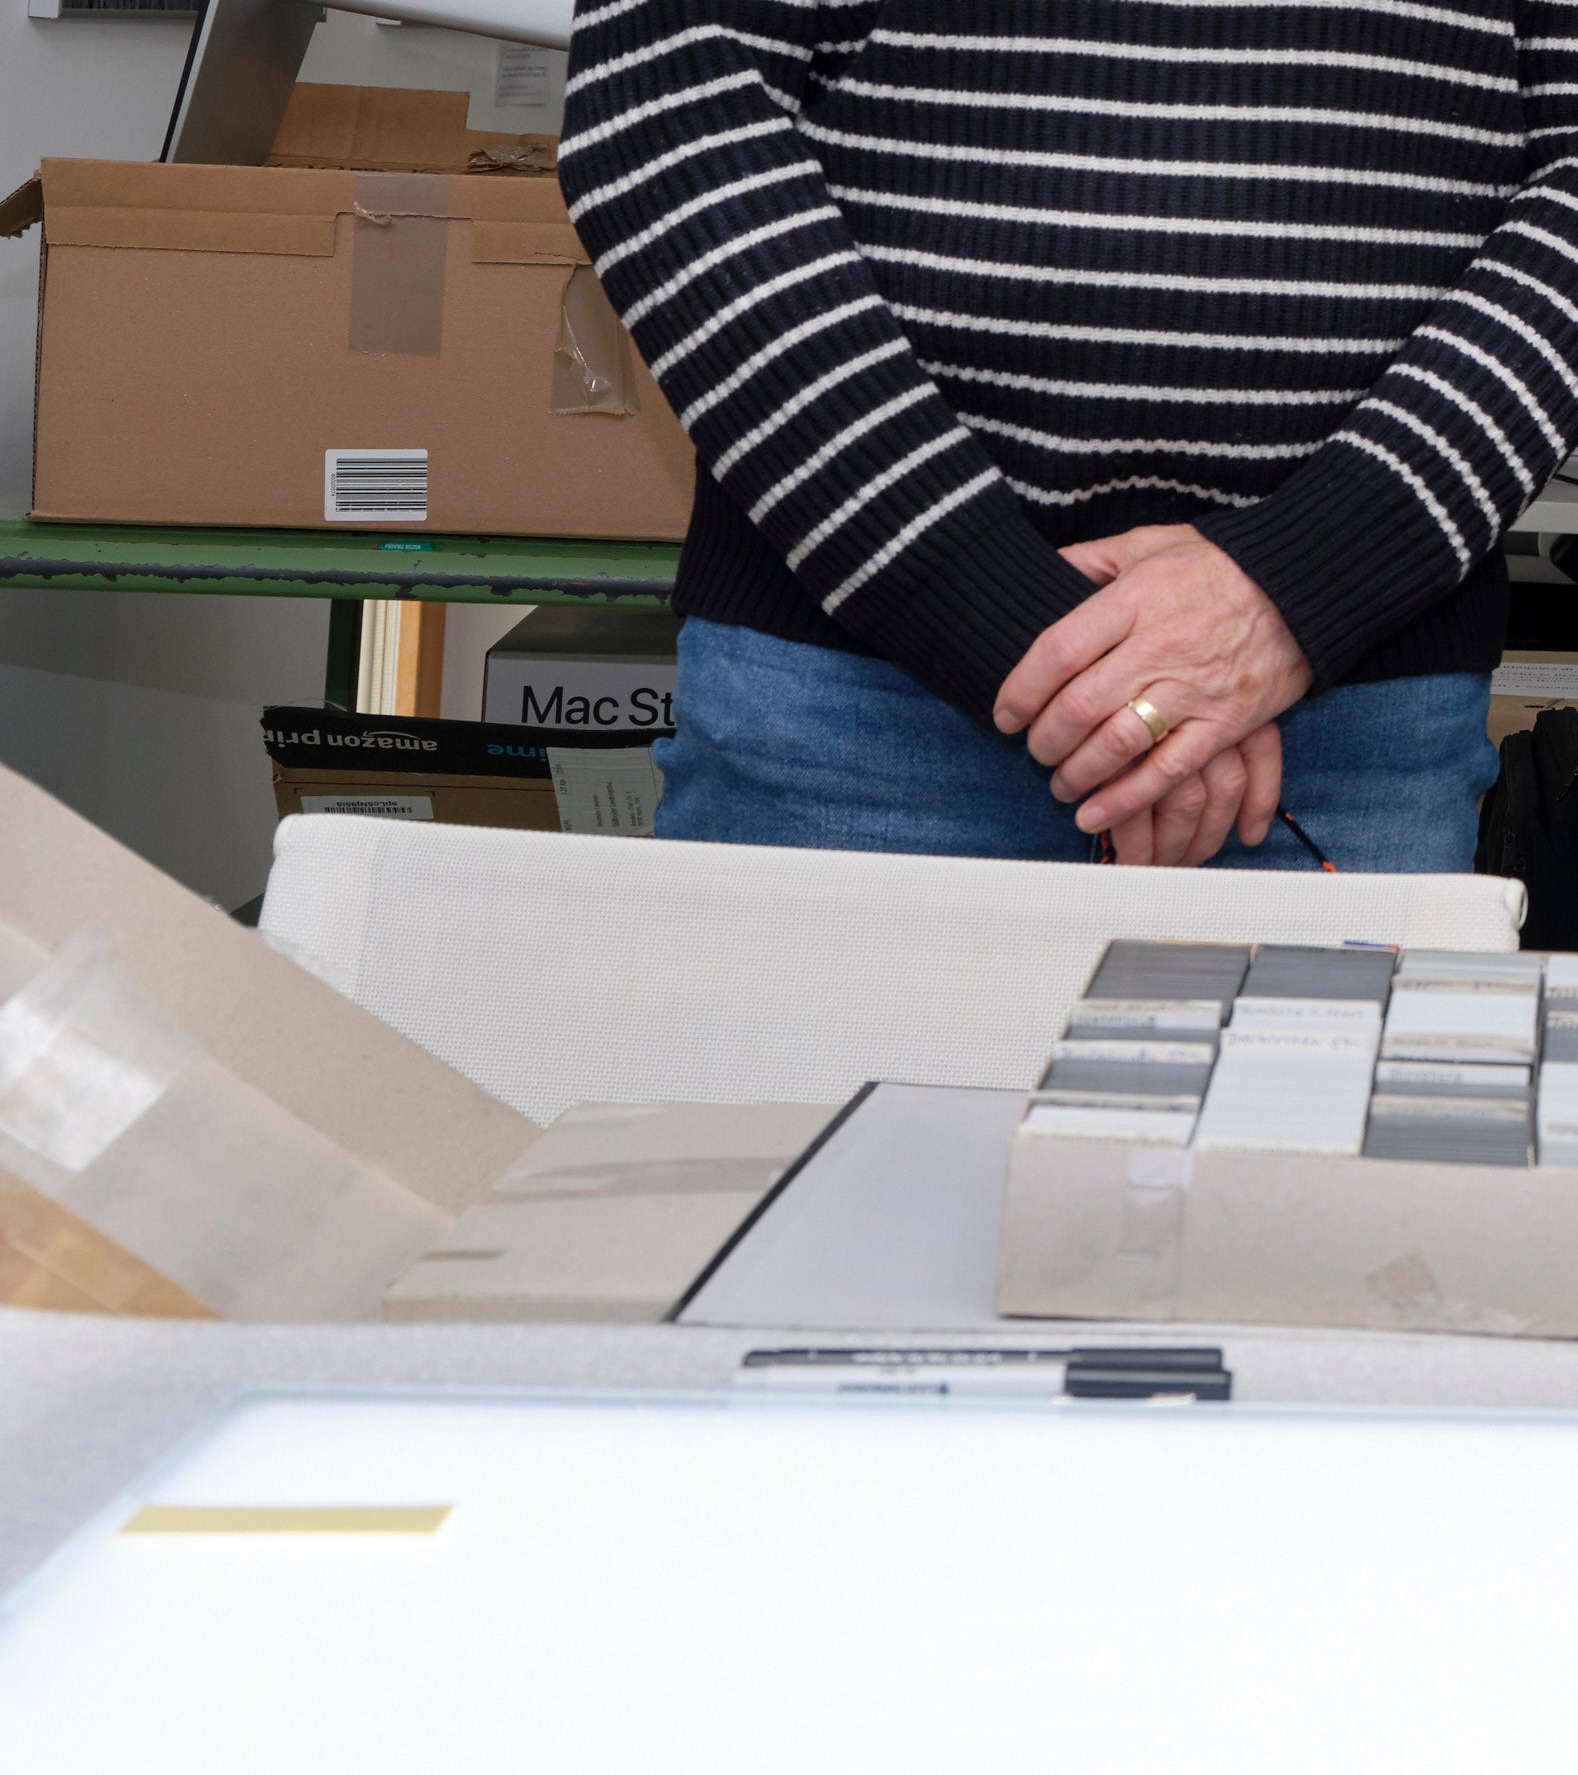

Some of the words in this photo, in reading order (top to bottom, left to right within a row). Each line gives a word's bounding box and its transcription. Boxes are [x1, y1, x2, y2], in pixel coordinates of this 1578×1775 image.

[521, 685, 620, 725] Mac
[628, 687, 676, 727] St
[327, 733, 438, 752] amazon
